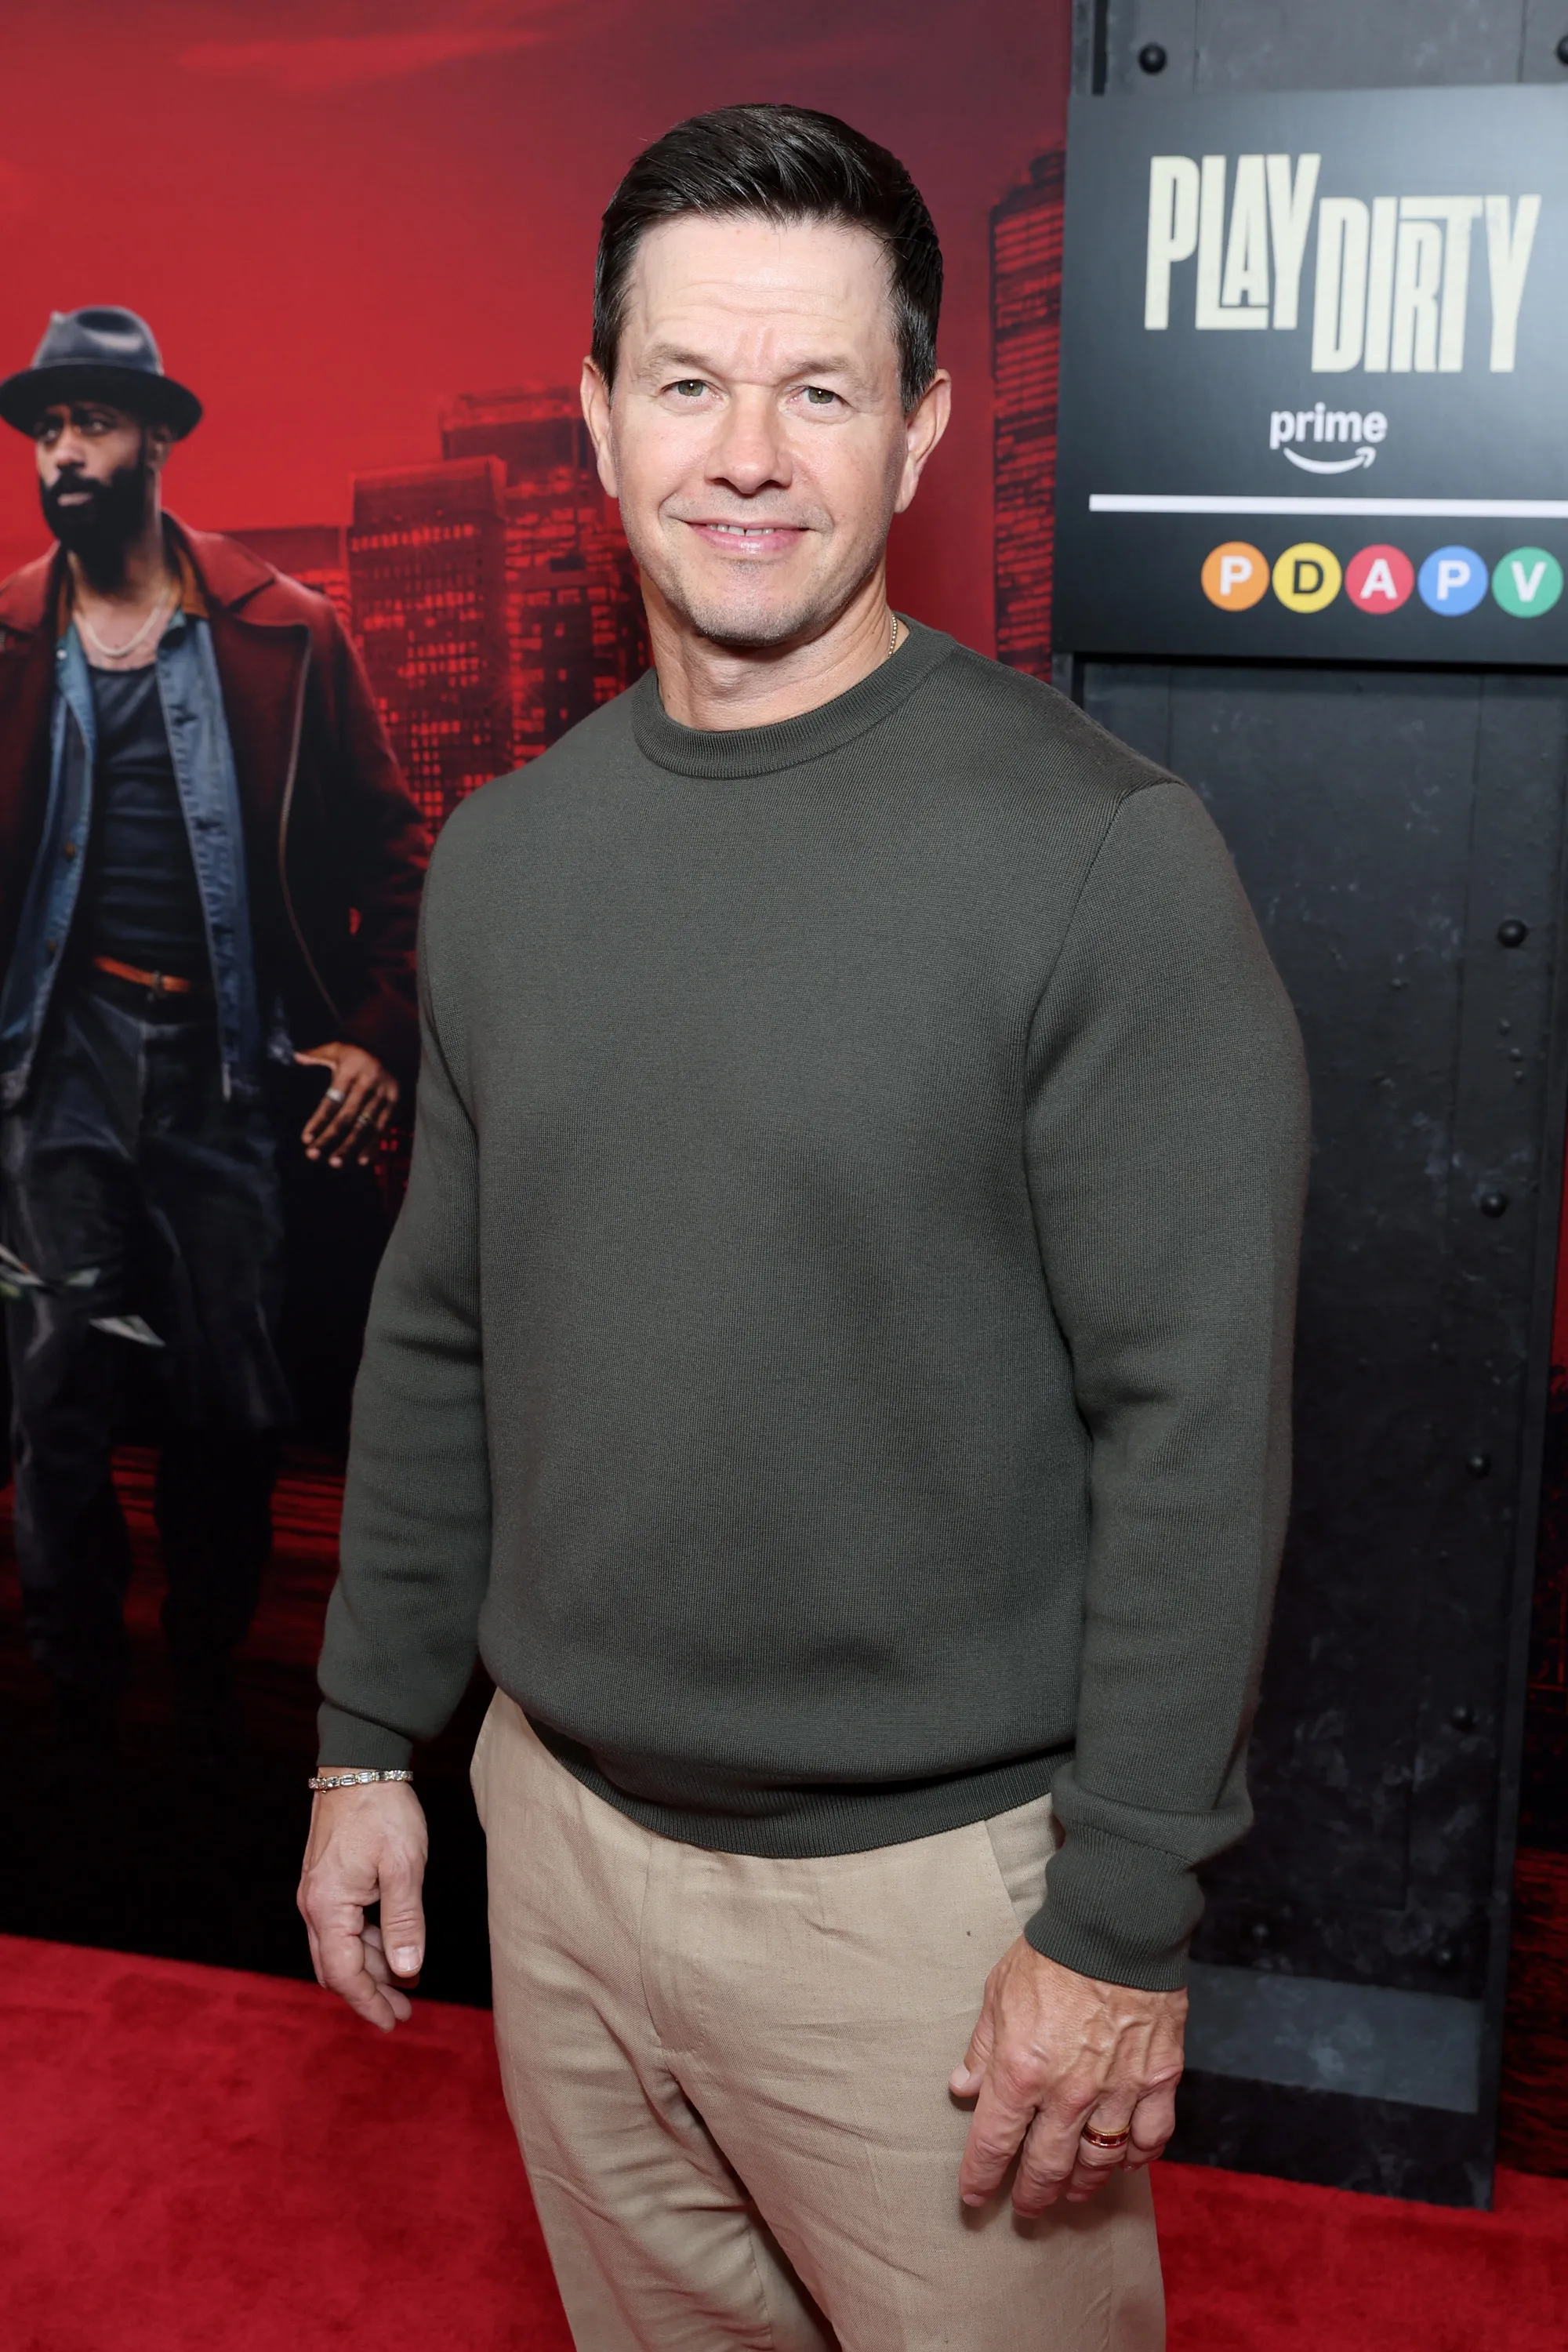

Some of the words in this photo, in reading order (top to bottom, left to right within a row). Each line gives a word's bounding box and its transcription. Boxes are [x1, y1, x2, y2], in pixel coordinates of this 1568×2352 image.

[1144, 153, 1321, 331] PLAY
[1311, 194, 1542, 373] DIRTY
[1269, 402, 1388, 450] prime
[1219, 556, 1253, 596] P
[1293, 560, 1325, 595] D
[1359, 558, 1398, 601] A
[1436, 561, 1471, 601] P
[1511, 562, 1547, 602] V
